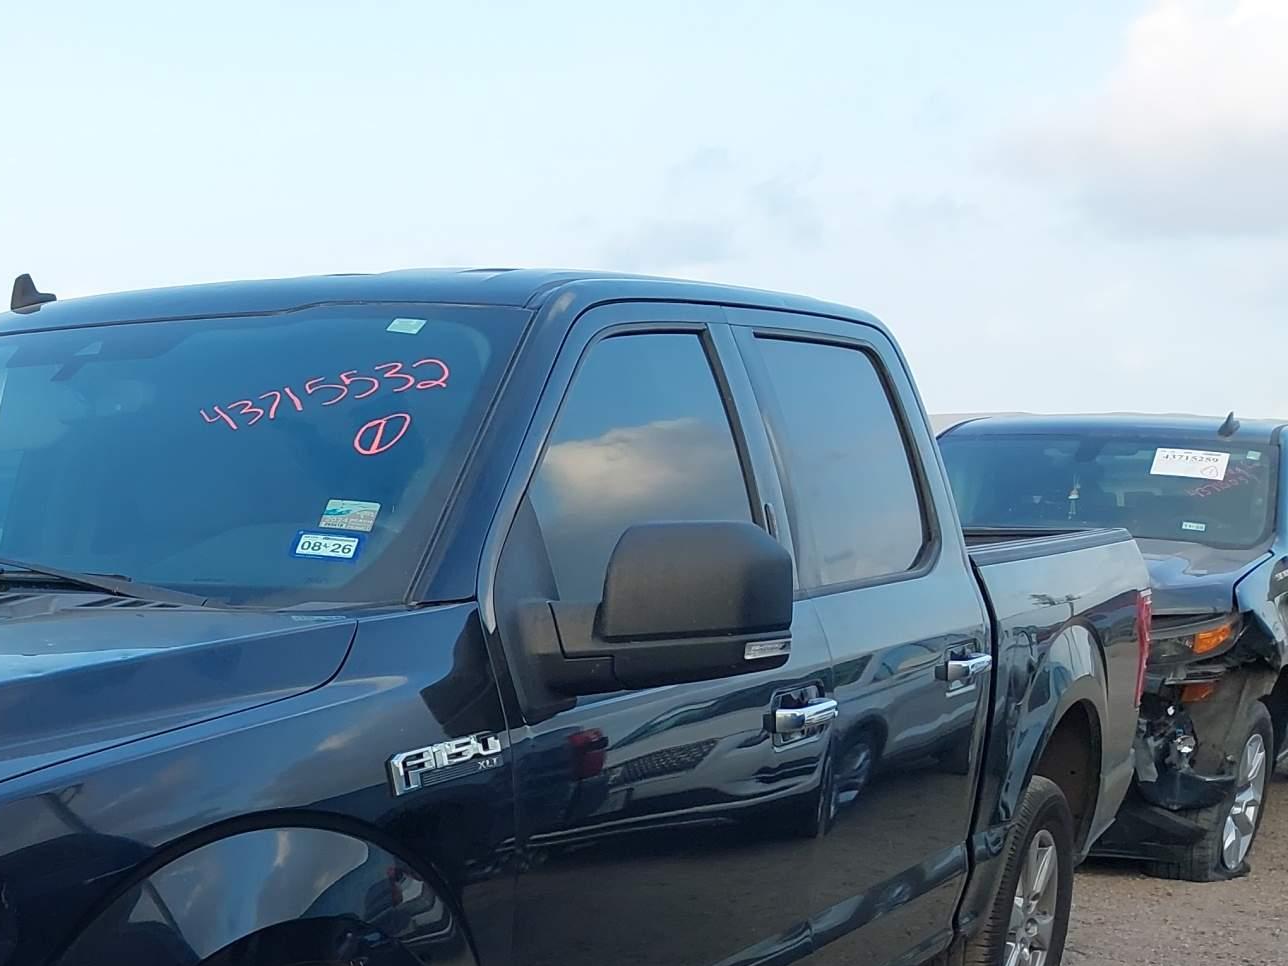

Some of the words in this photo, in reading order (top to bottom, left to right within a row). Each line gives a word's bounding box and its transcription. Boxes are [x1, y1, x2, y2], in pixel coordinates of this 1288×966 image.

[199, 358, 450, 431] 43715532
[300, 540, 323, 552] 08
[329, 542, 354, 555] 26
[477, 756, 499, 770] XLT
